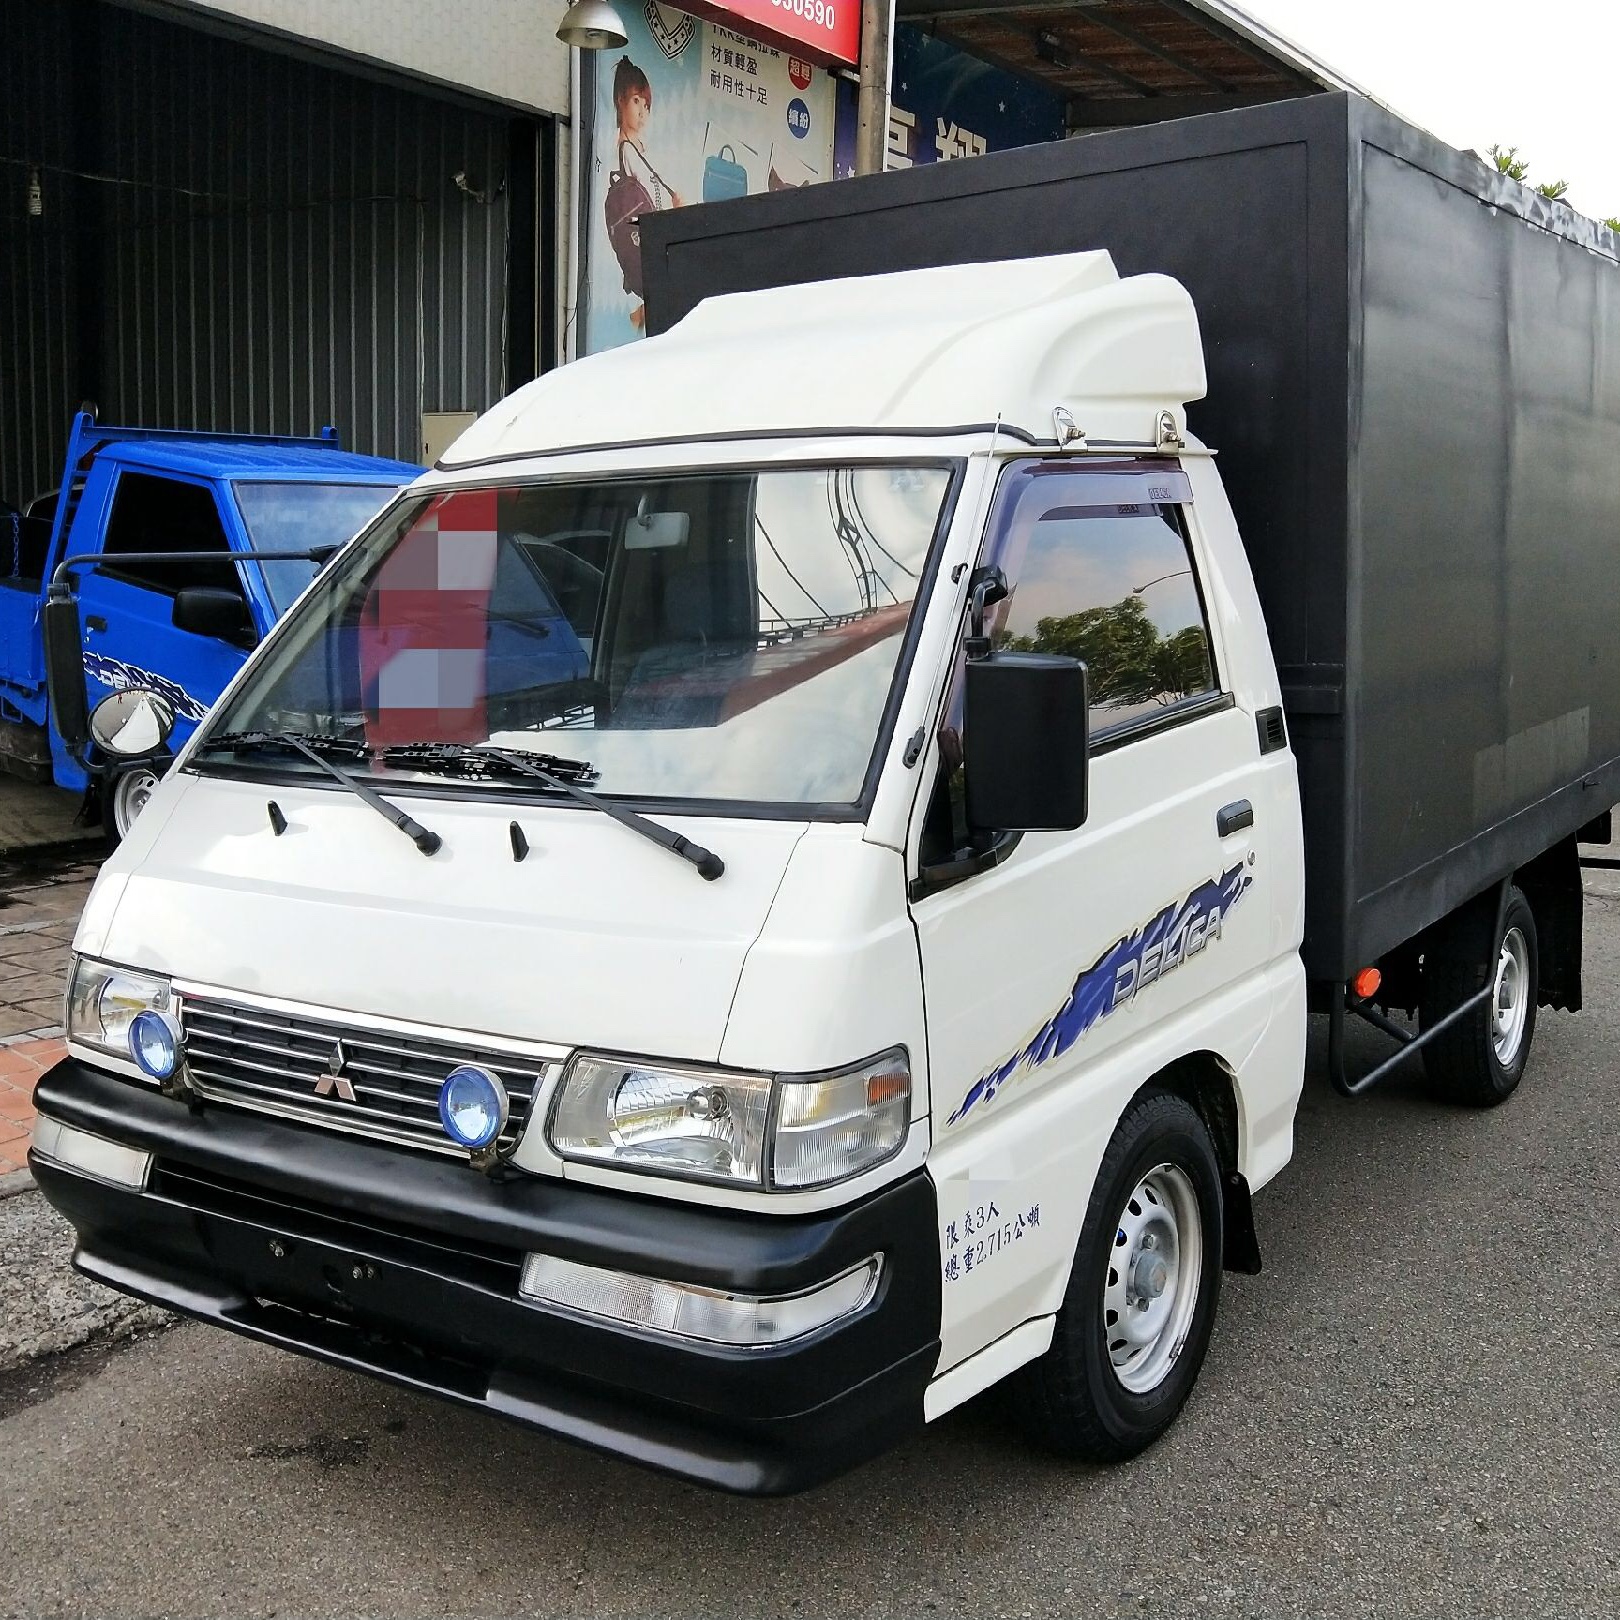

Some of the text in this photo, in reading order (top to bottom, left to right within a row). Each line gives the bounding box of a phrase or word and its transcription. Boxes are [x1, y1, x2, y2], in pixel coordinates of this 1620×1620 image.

[771, 0, 835, 30] 0590
[710, 43, 758, 76] 材質輕盈
[710, 69, 768, 106] 耐用性十足
[788, 109, 809, 129] 繽紛
[1112, 906, 1221, 1006] DELICA
[946, 1202, 999, 1250] 限乘3人
